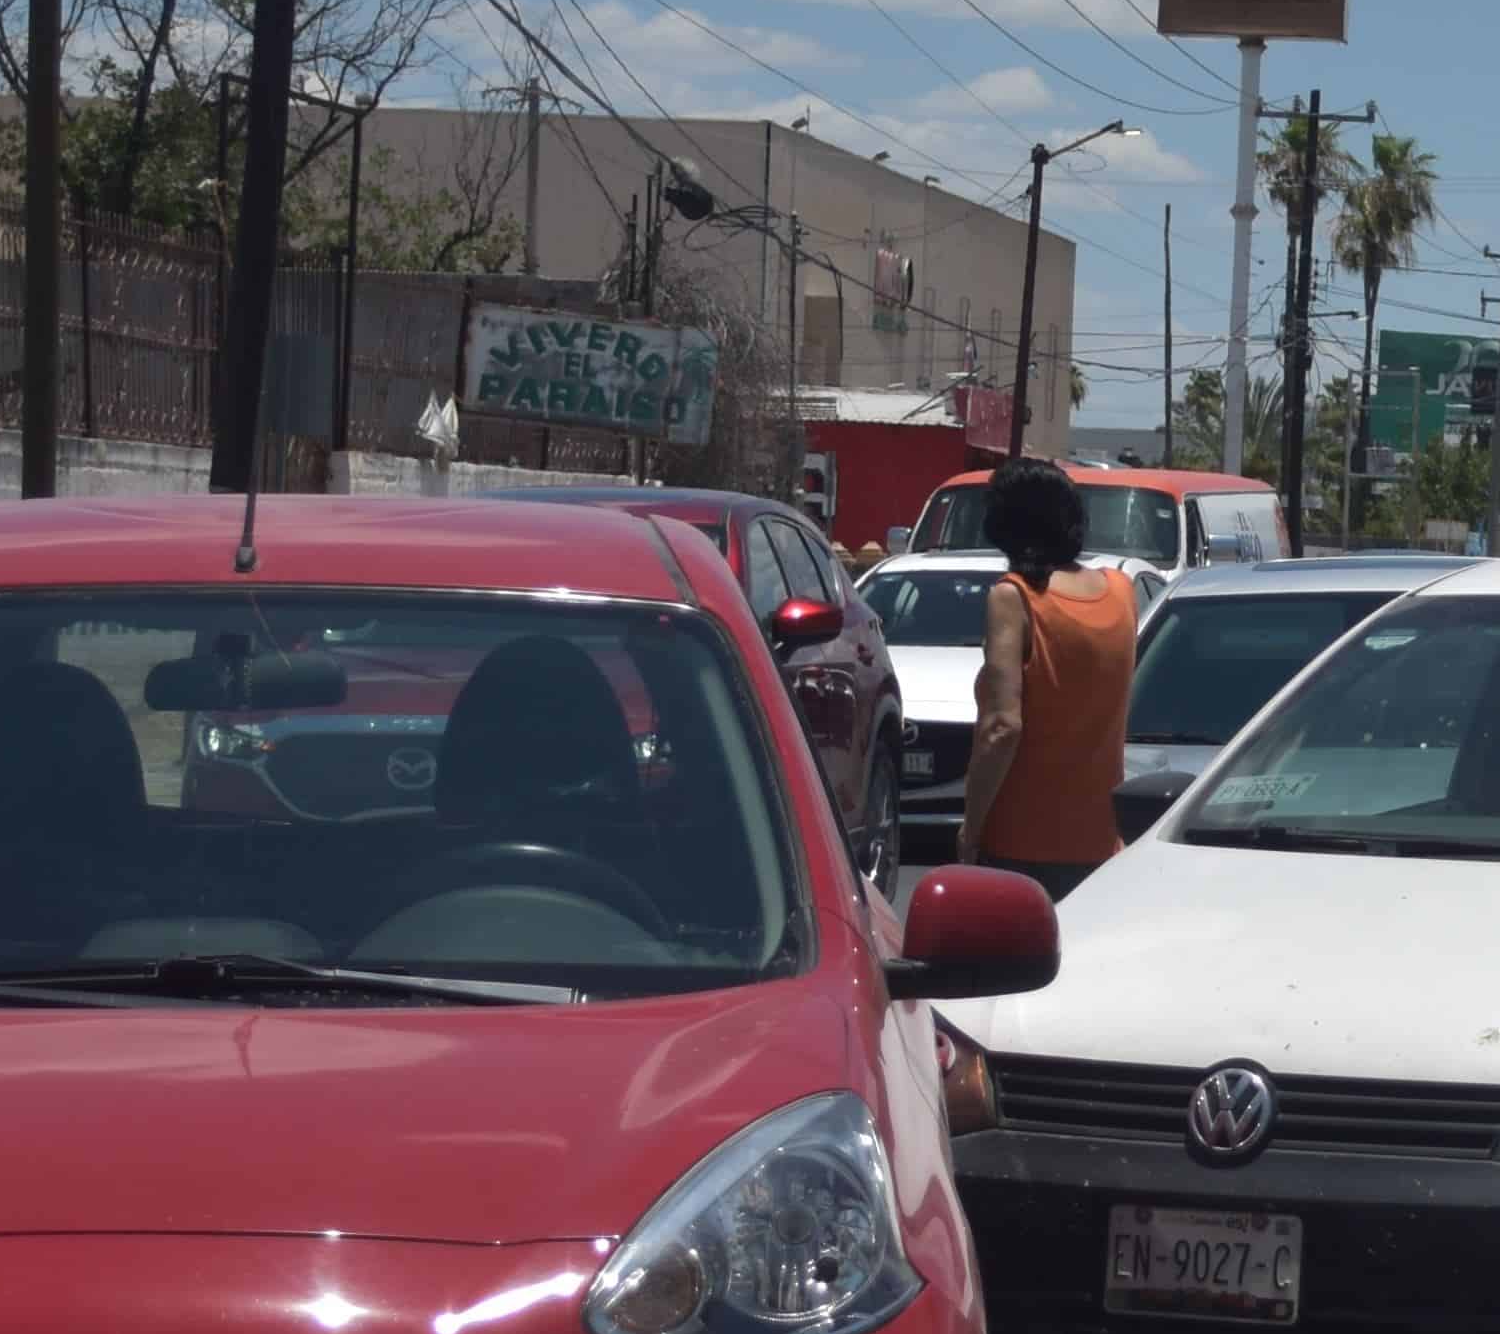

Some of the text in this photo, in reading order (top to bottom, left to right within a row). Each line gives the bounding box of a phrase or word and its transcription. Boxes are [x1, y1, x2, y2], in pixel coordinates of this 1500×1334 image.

[489, 321, 669, 381] VIVERO
[564, 352, 599, 379] EL
[478, 372, 687, 425] PARAISO
[1426, 371, 1474, 397] JA
[1113, 1234, 1292, 1291] EN-9027-C
